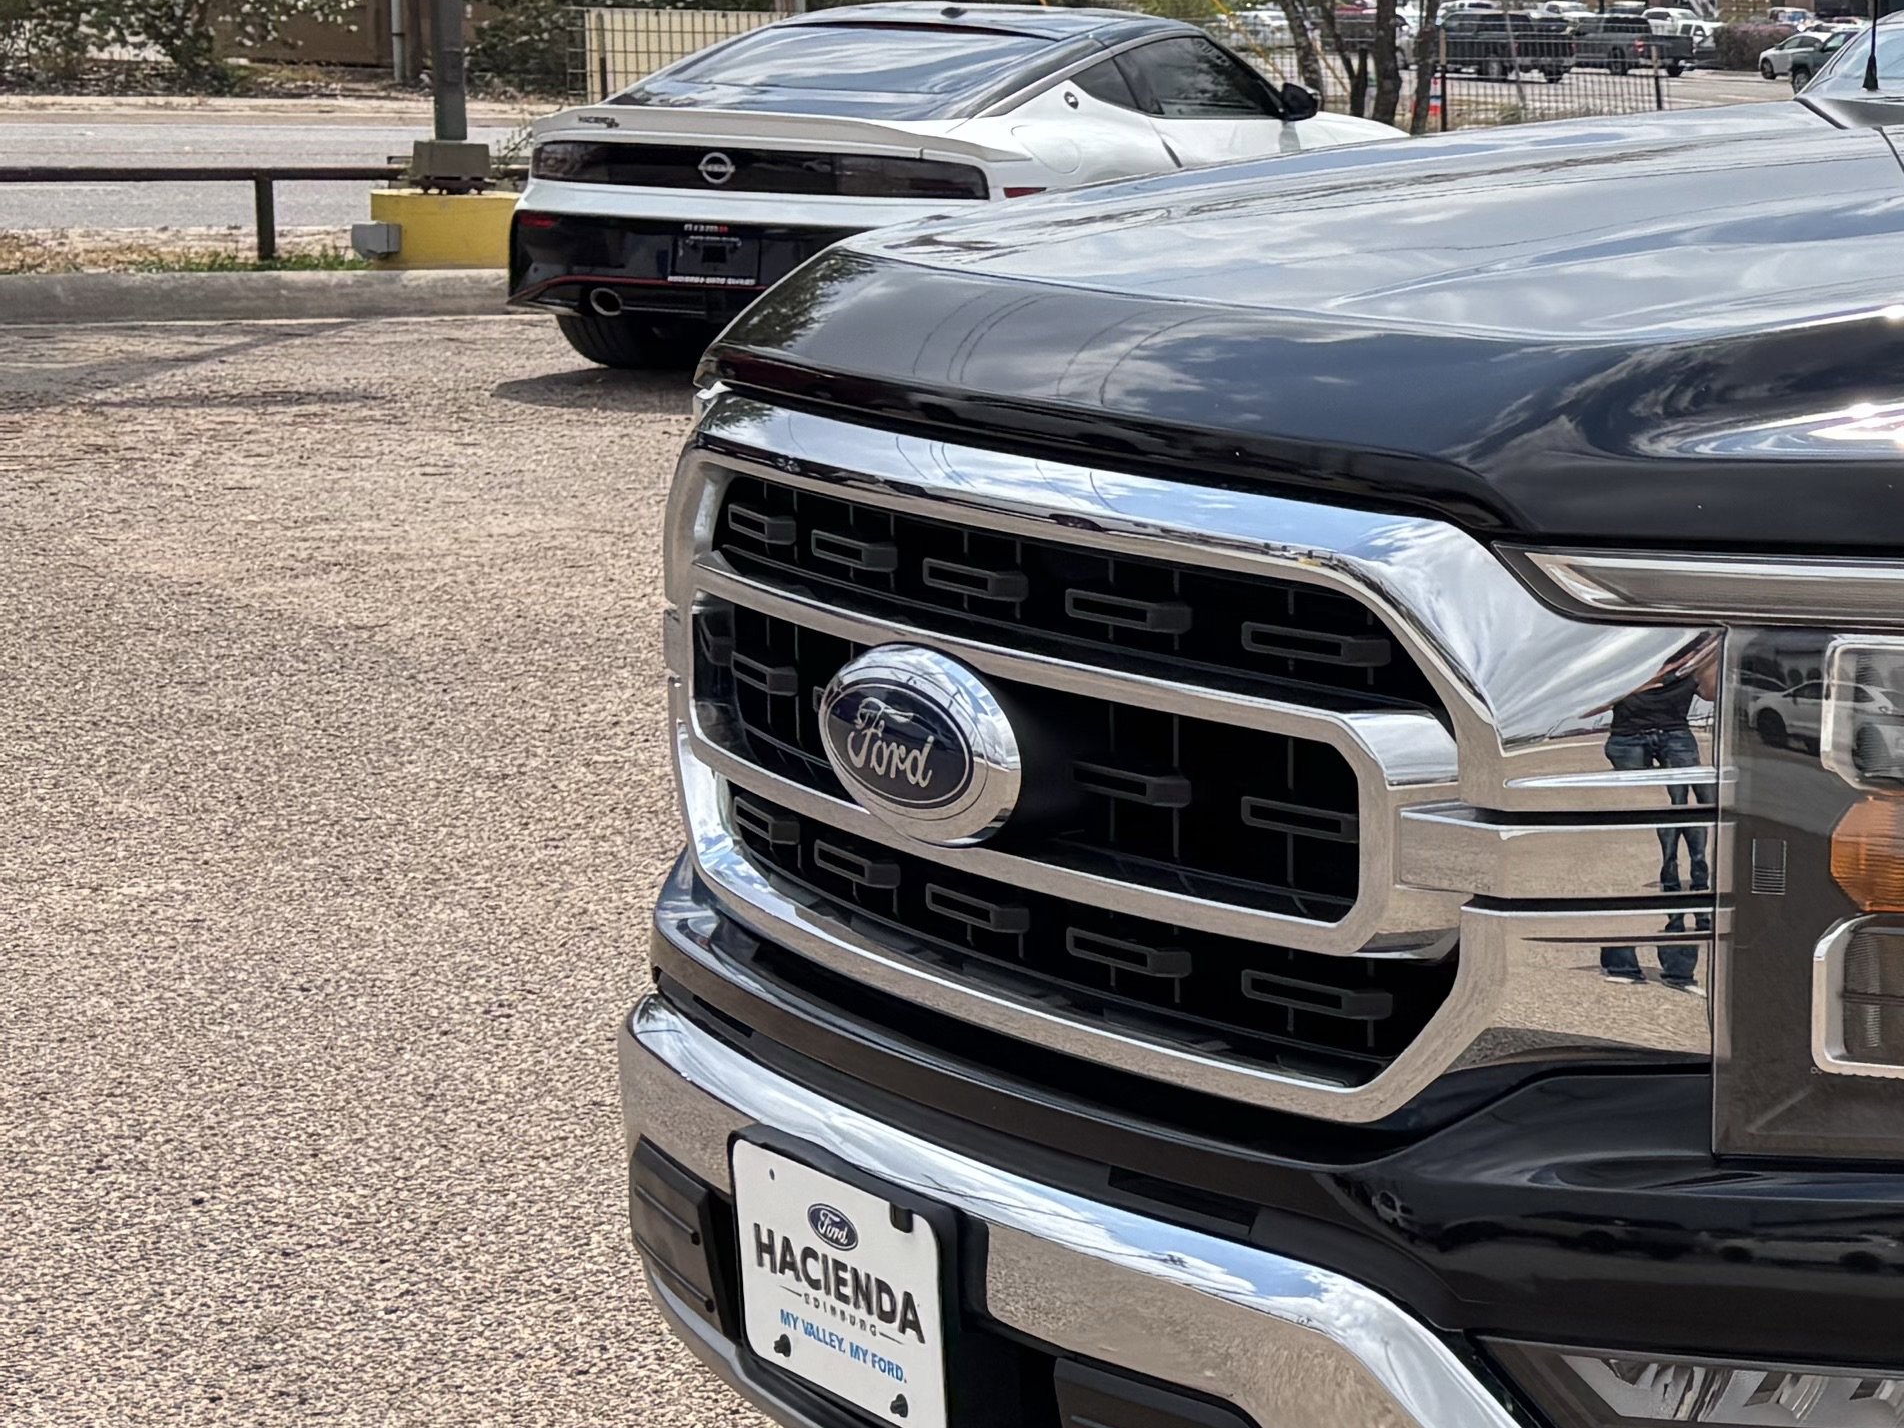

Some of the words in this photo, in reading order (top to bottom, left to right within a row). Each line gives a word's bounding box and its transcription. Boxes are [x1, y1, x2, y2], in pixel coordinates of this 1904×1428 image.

[847, 696, 935, 788] Ford
[818, 1209, 849, 1245] Ford
[753, 1222, 926, 1345] HACIENDA
[803, 1292, 877, 1337] EDINBURG
[780, 1308, 799, 1331] MY
[849, 1341, 869, 1364] MY
[871, 1353, 908, 1383] FORD.
